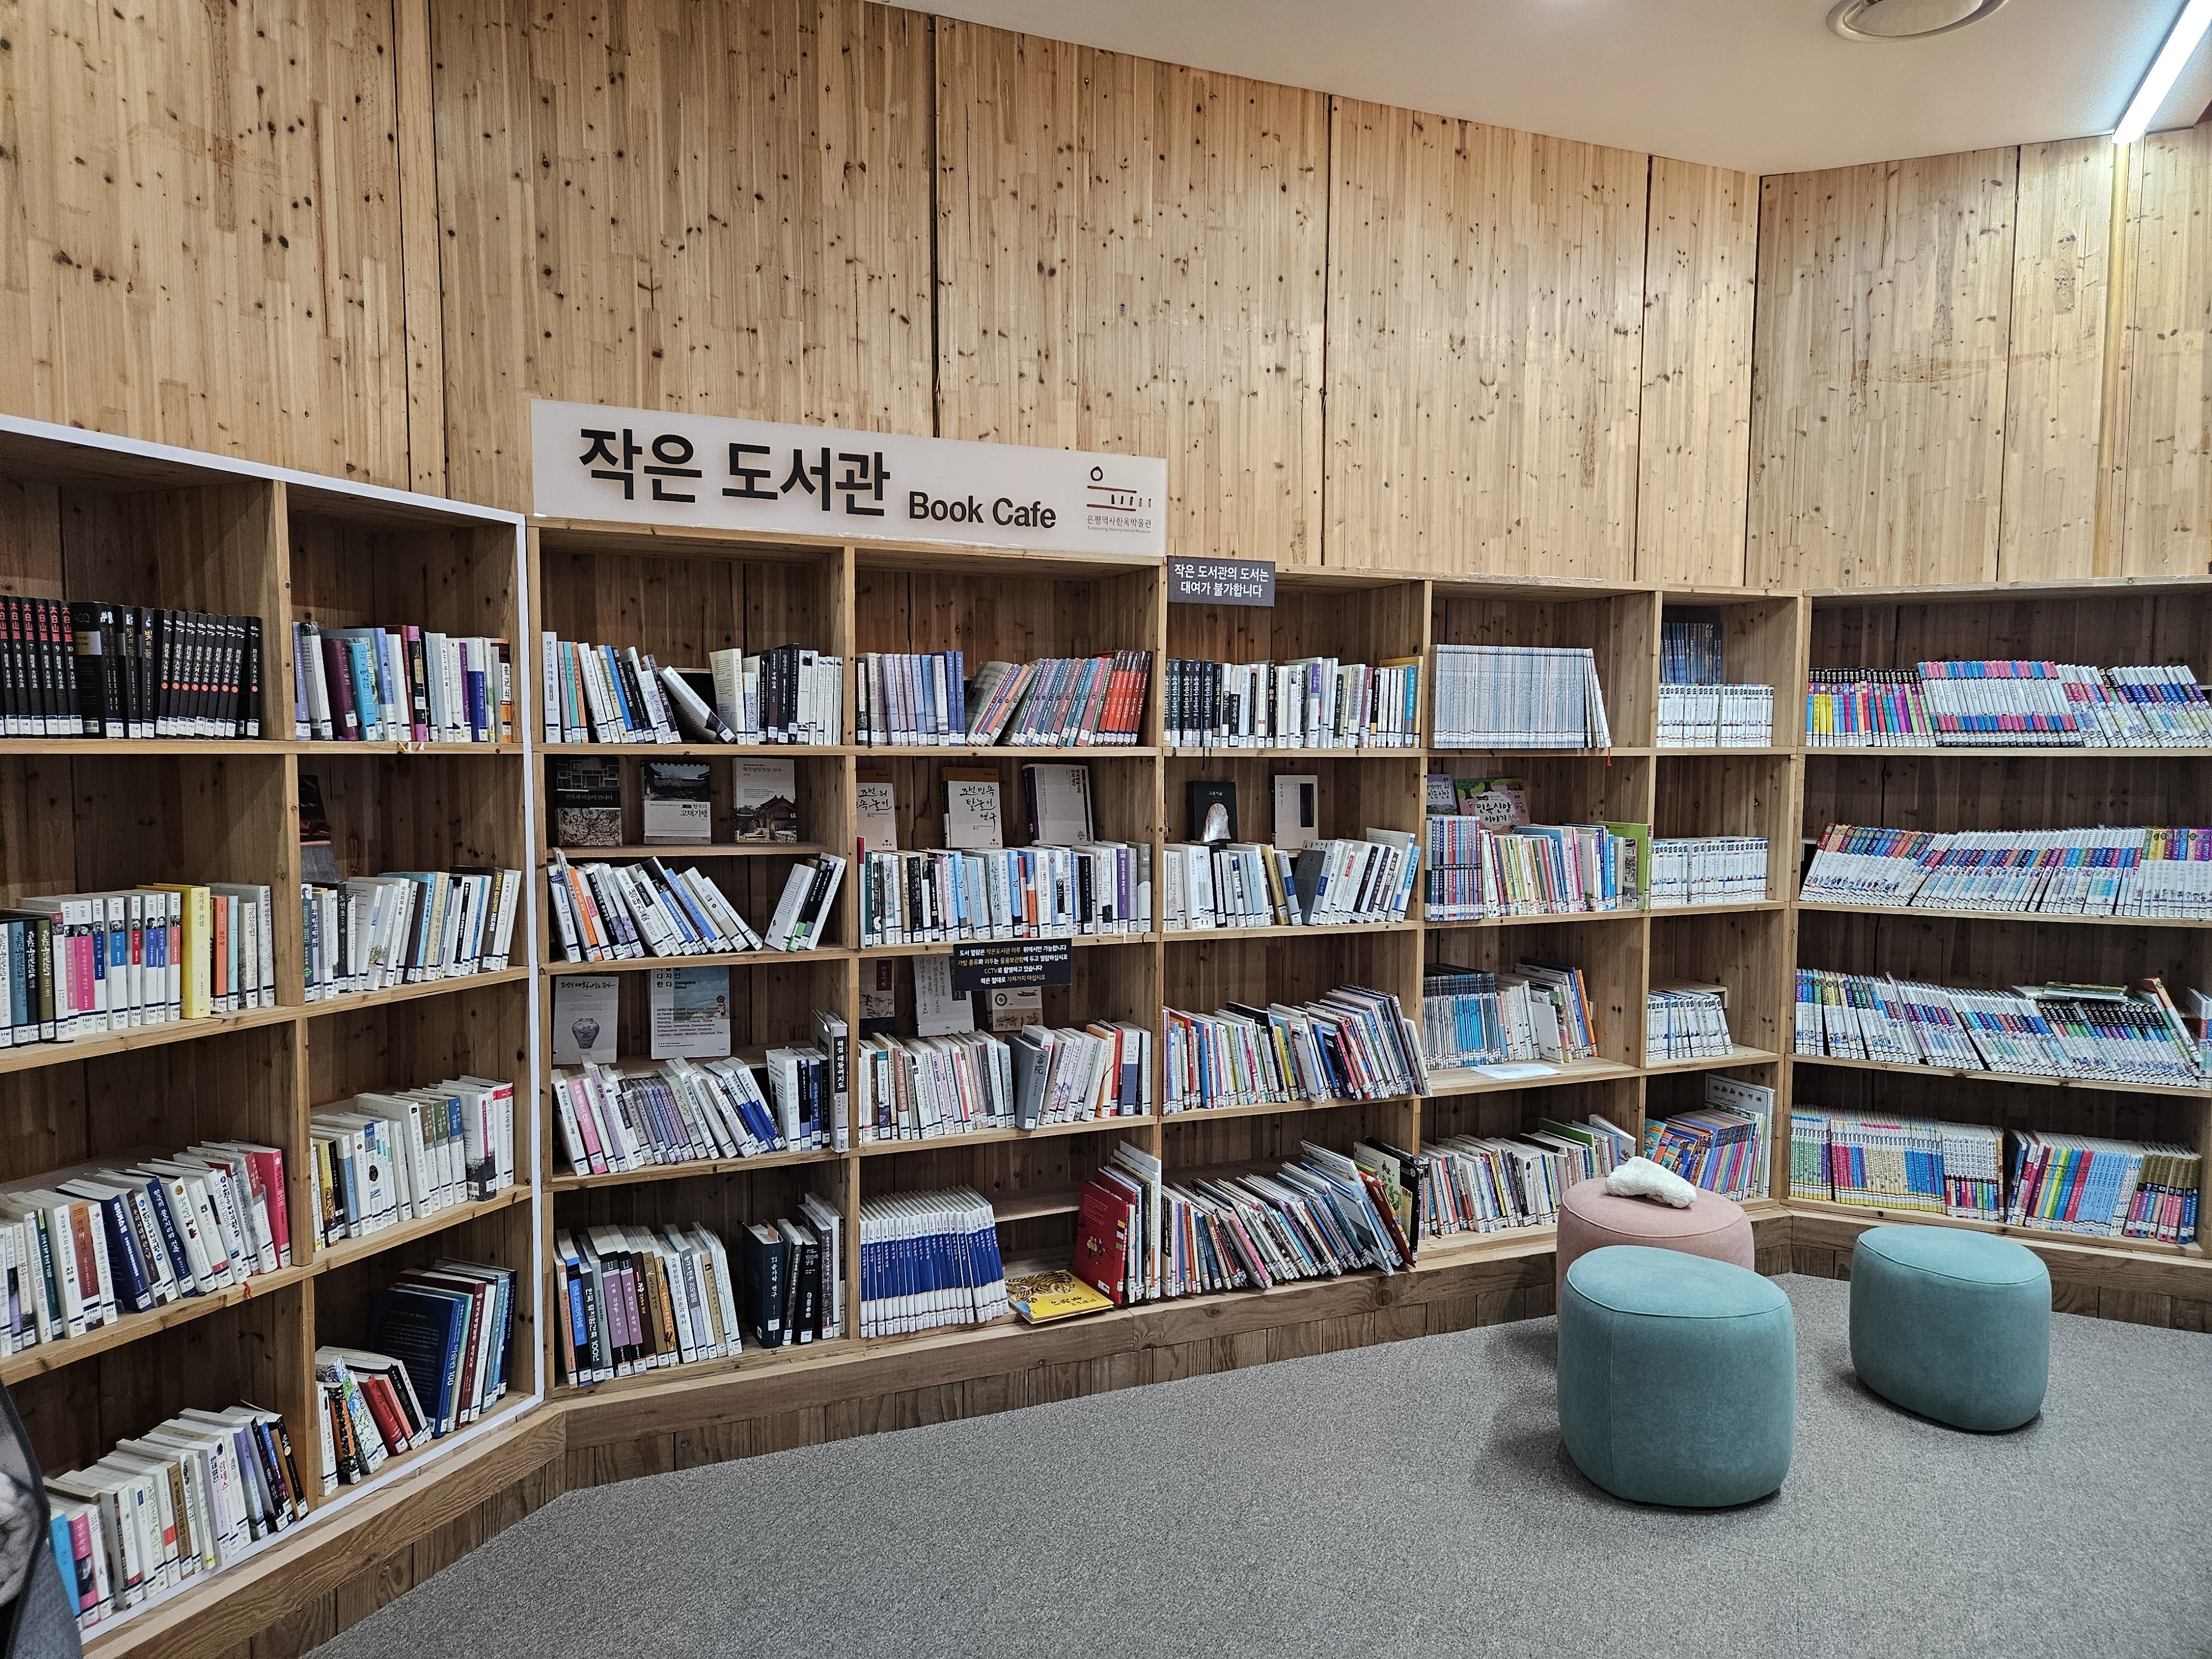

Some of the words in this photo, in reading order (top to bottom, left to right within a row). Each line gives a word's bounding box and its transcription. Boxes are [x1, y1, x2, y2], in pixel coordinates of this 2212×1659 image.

[580, 428, 704, 503] 작은
[721, 444, 891, 517] 도서관
[909, 490, 983, 525] Book
[993, 497, 1056, 529] Cafe
[1087, 515, 1151, 528] 은평역사한옥박물관
[1175, 564, 1194, 578] 작은
[1198, 566, 1237, 581] 도서관의
[1240, 568, 1269, 582] 도서는
[1181, 582, 1211, 595] 대여가
[1214, 583, 1262, 597] 불가합니다
[660, 692, 668, 706] 인문학
[966, 798, 996, 811] 탈놀이
[1477, 802, 1511, 815] 민속신앙
[980, 812, 997, 834] 연구
[494, 872, 503, 890] 대한민국
[957, 880, 963, 889] 10
[491, 891, 500, 912] 임시정부의
[627, 887, 649, 922] 생태건축
[198, 914, 204, 927] 전집
[488, 912, 497, 931] 지도자들
[1035, 1054, 1046, 1074] 書院
[582, 1113, 592, 1132] 만화까지
[218, 1199, 226, 1211] 내가
[153, 1188, 164, 1207] 한국의
[159, 1209, 174, 1239] 풍수지리와
[169, 1239, 180, 1253] 건축
[221, 1211, 231, 1228] 있었네
[65, 1266, 74, 1275] 집
[585, 1288, 593, 1302] 한국
[688, 1282, 697, 1303] 리모델링
[587, 1304, 597, 1338] 뮤지엄건축
[680, 1314, 686, 1324] 역사
[591, 1340, 599, 1361] 100년
[217, 1460, 229, 1490] 람세스
